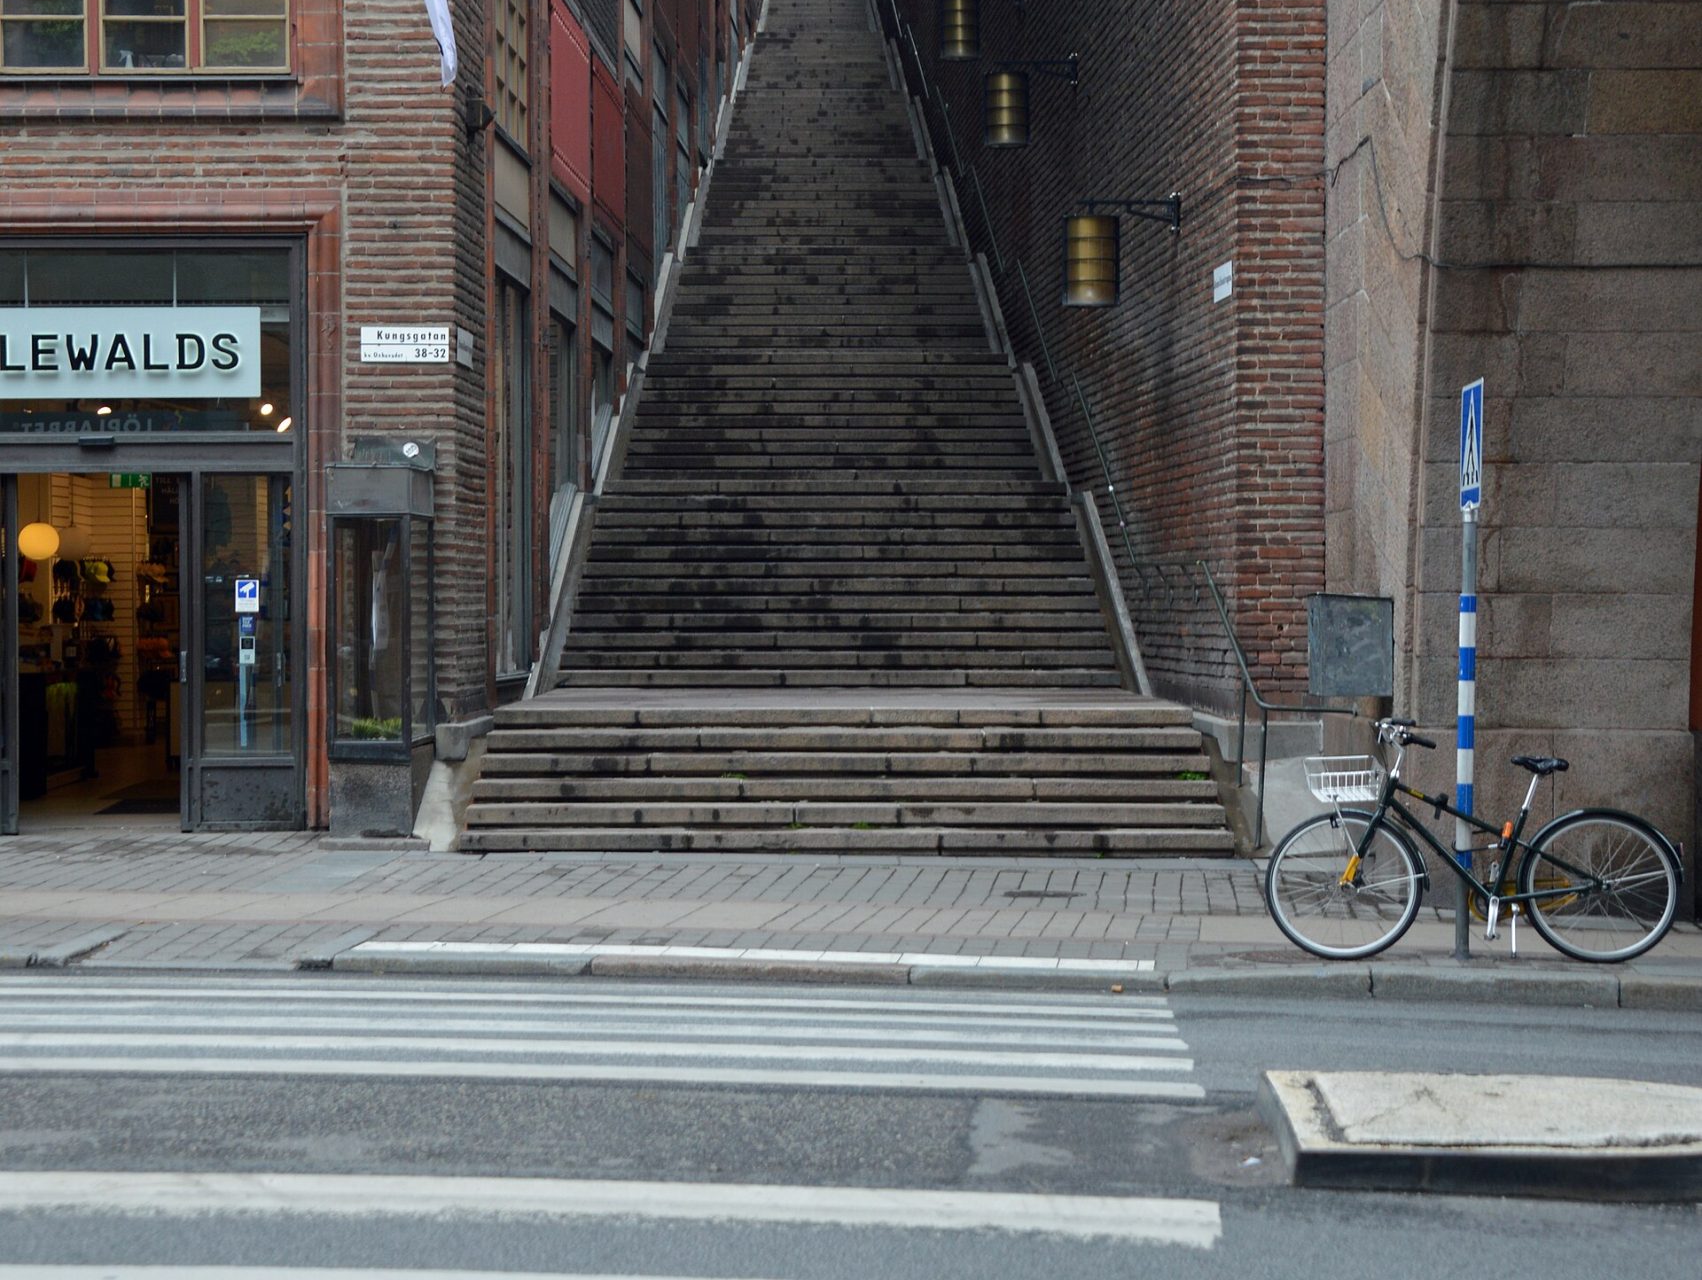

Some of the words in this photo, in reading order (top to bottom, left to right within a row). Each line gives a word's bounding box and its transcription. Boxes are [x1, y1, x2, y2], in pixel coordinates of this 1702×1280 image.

[376, 330, 447, 343] Kungsgatan
[0, 333, 240, 371] LEWALDS
[414, 348, 447, 359] 38-32
